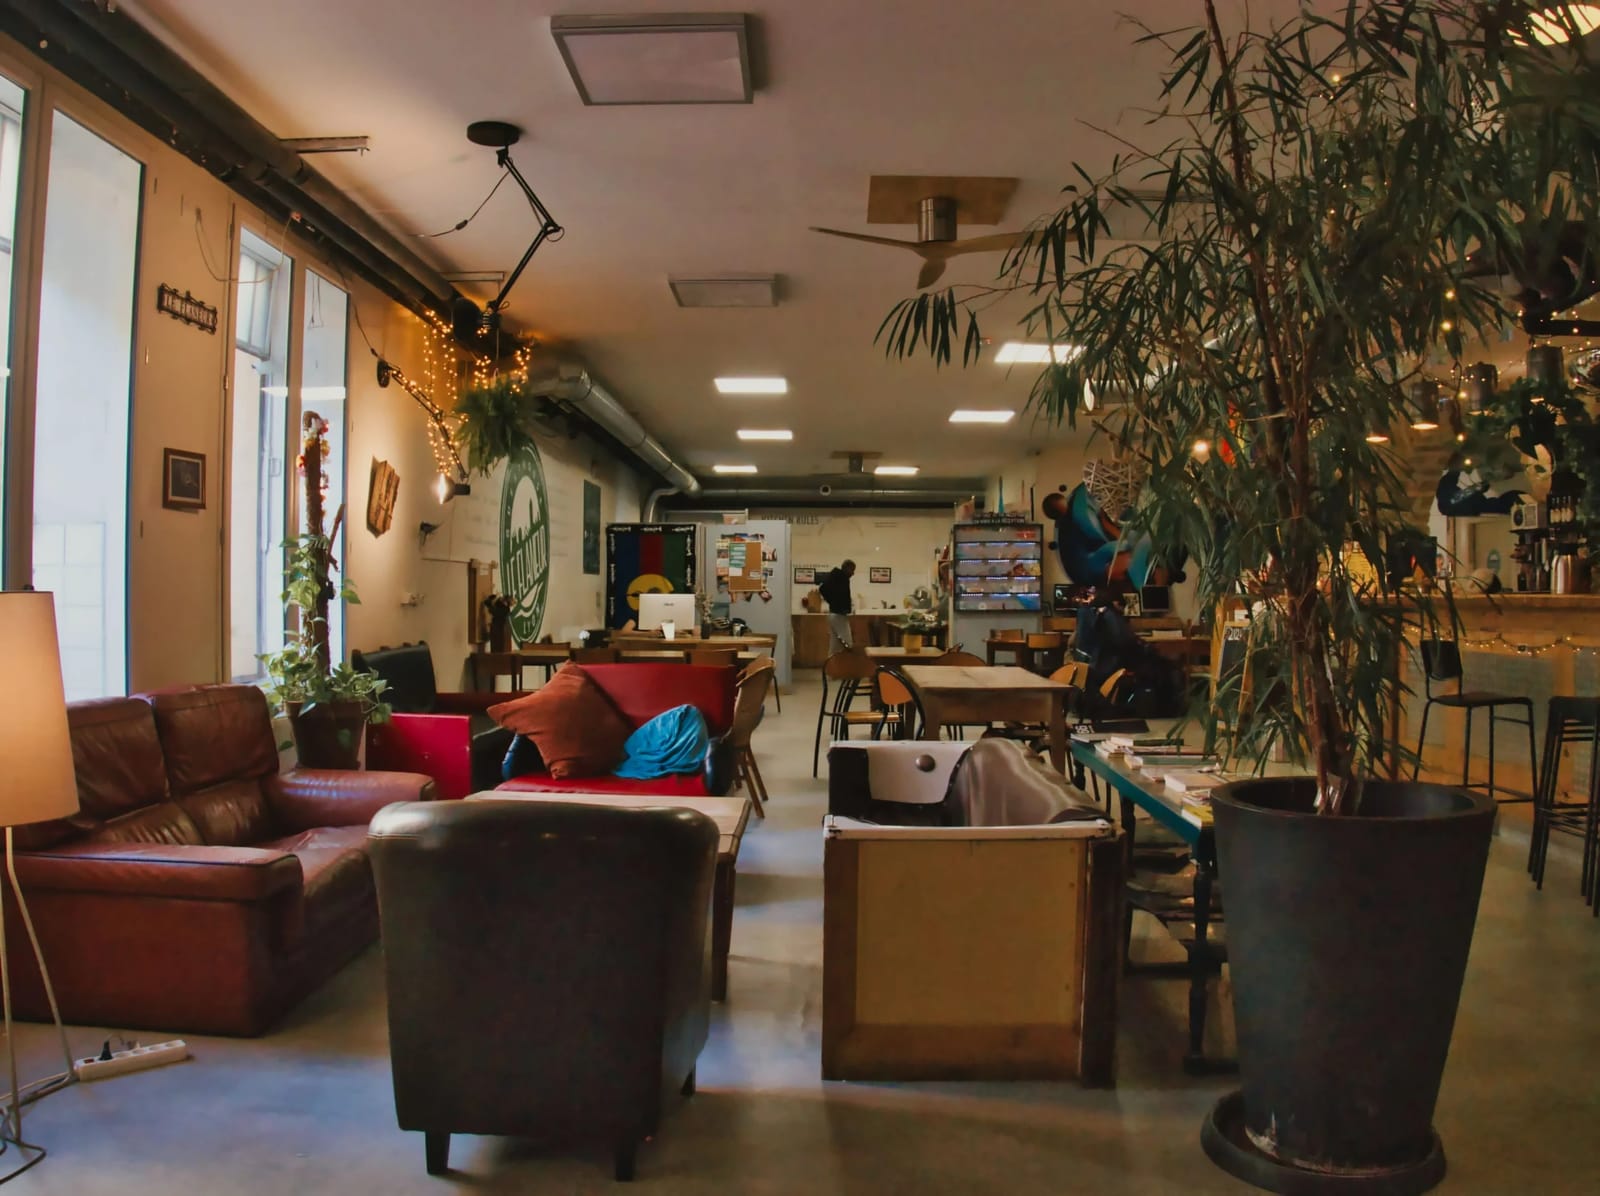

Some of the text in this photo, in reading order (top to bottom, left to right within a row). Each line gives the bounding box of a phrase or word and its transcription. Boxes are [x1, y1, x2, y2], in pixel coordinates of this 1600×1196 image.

[797, 514, 819, 525] RULES
[506, 556, 517, 598] LE
[517, 600, 540, 634] LYON
